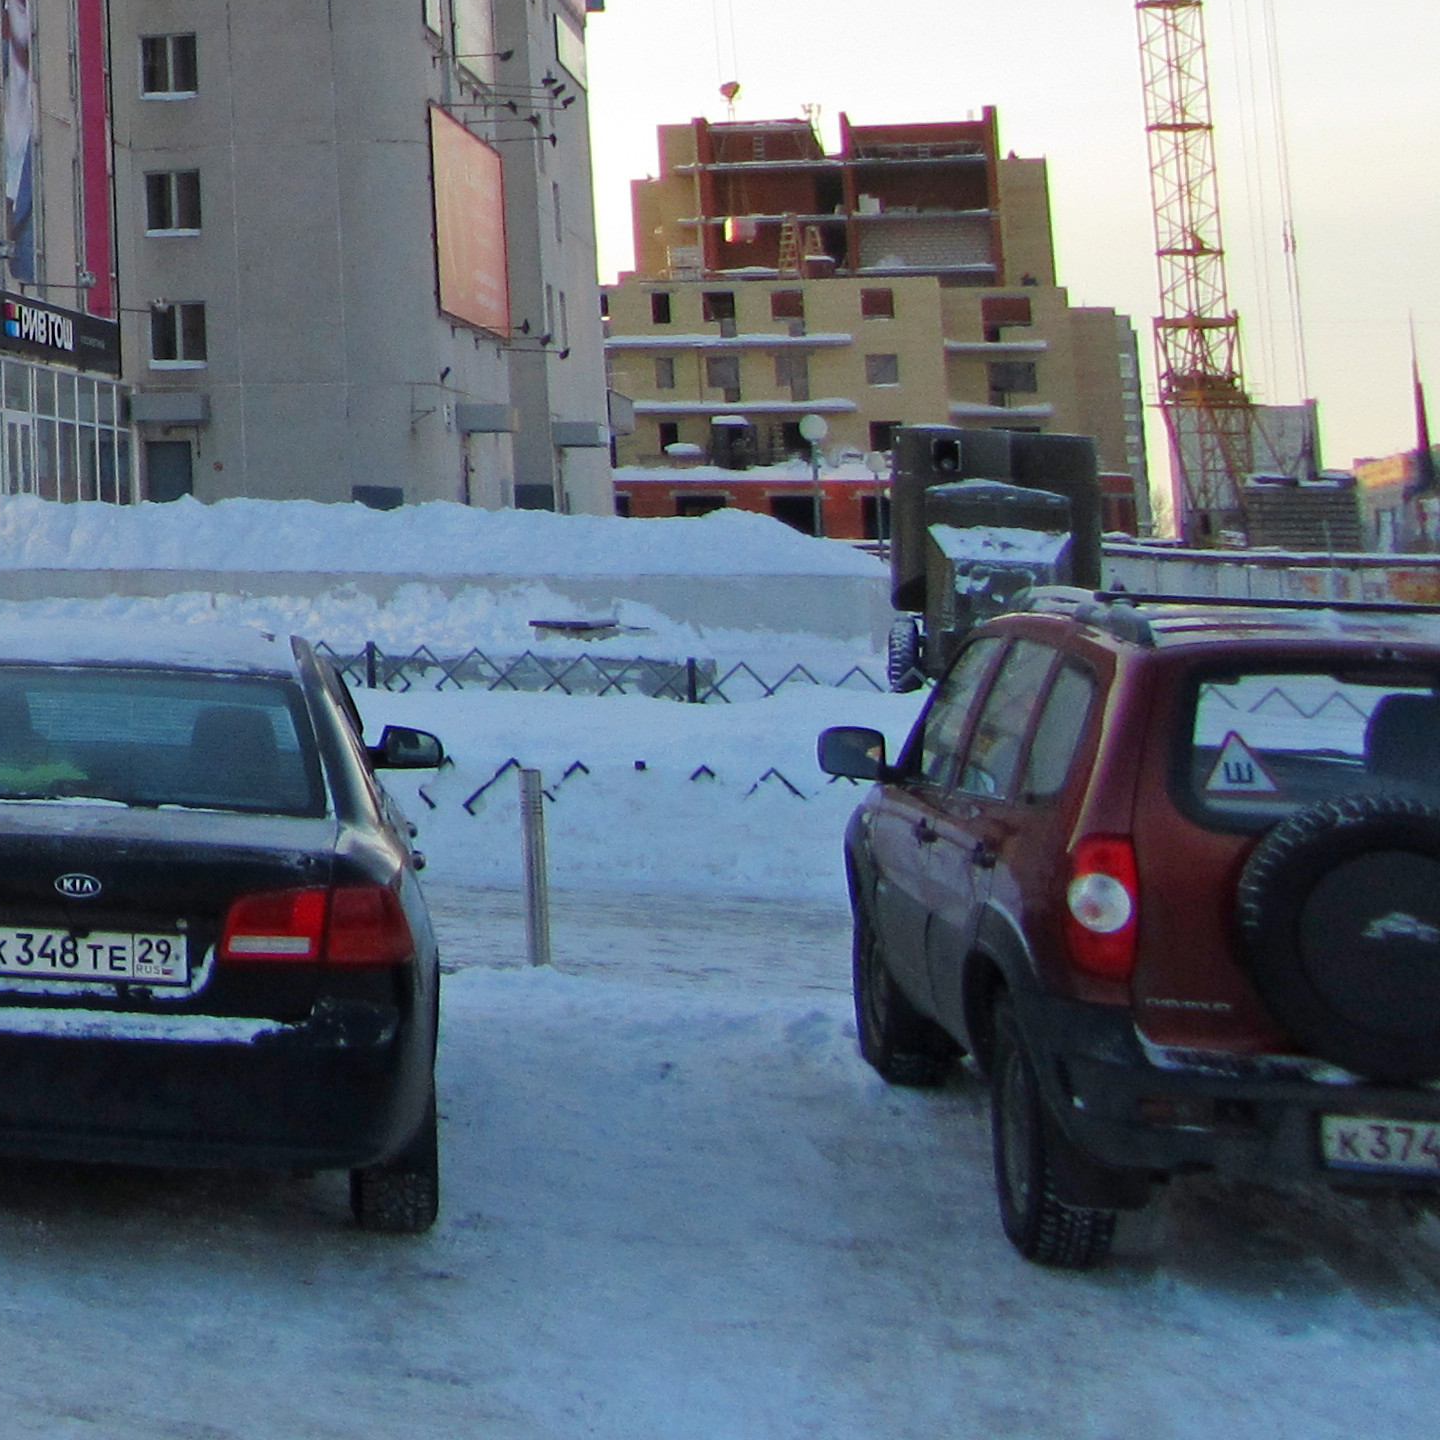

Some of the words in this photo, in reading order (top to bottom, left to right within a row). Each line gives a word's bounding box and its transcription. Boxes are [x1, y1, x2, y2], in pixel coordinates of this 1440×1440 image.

[1223, 762, 1255, 784] Ш
[63, 879, 94, 892] KIA
[137, 938, 171, 964] 29
[135, 964, 161, 975] RUS
